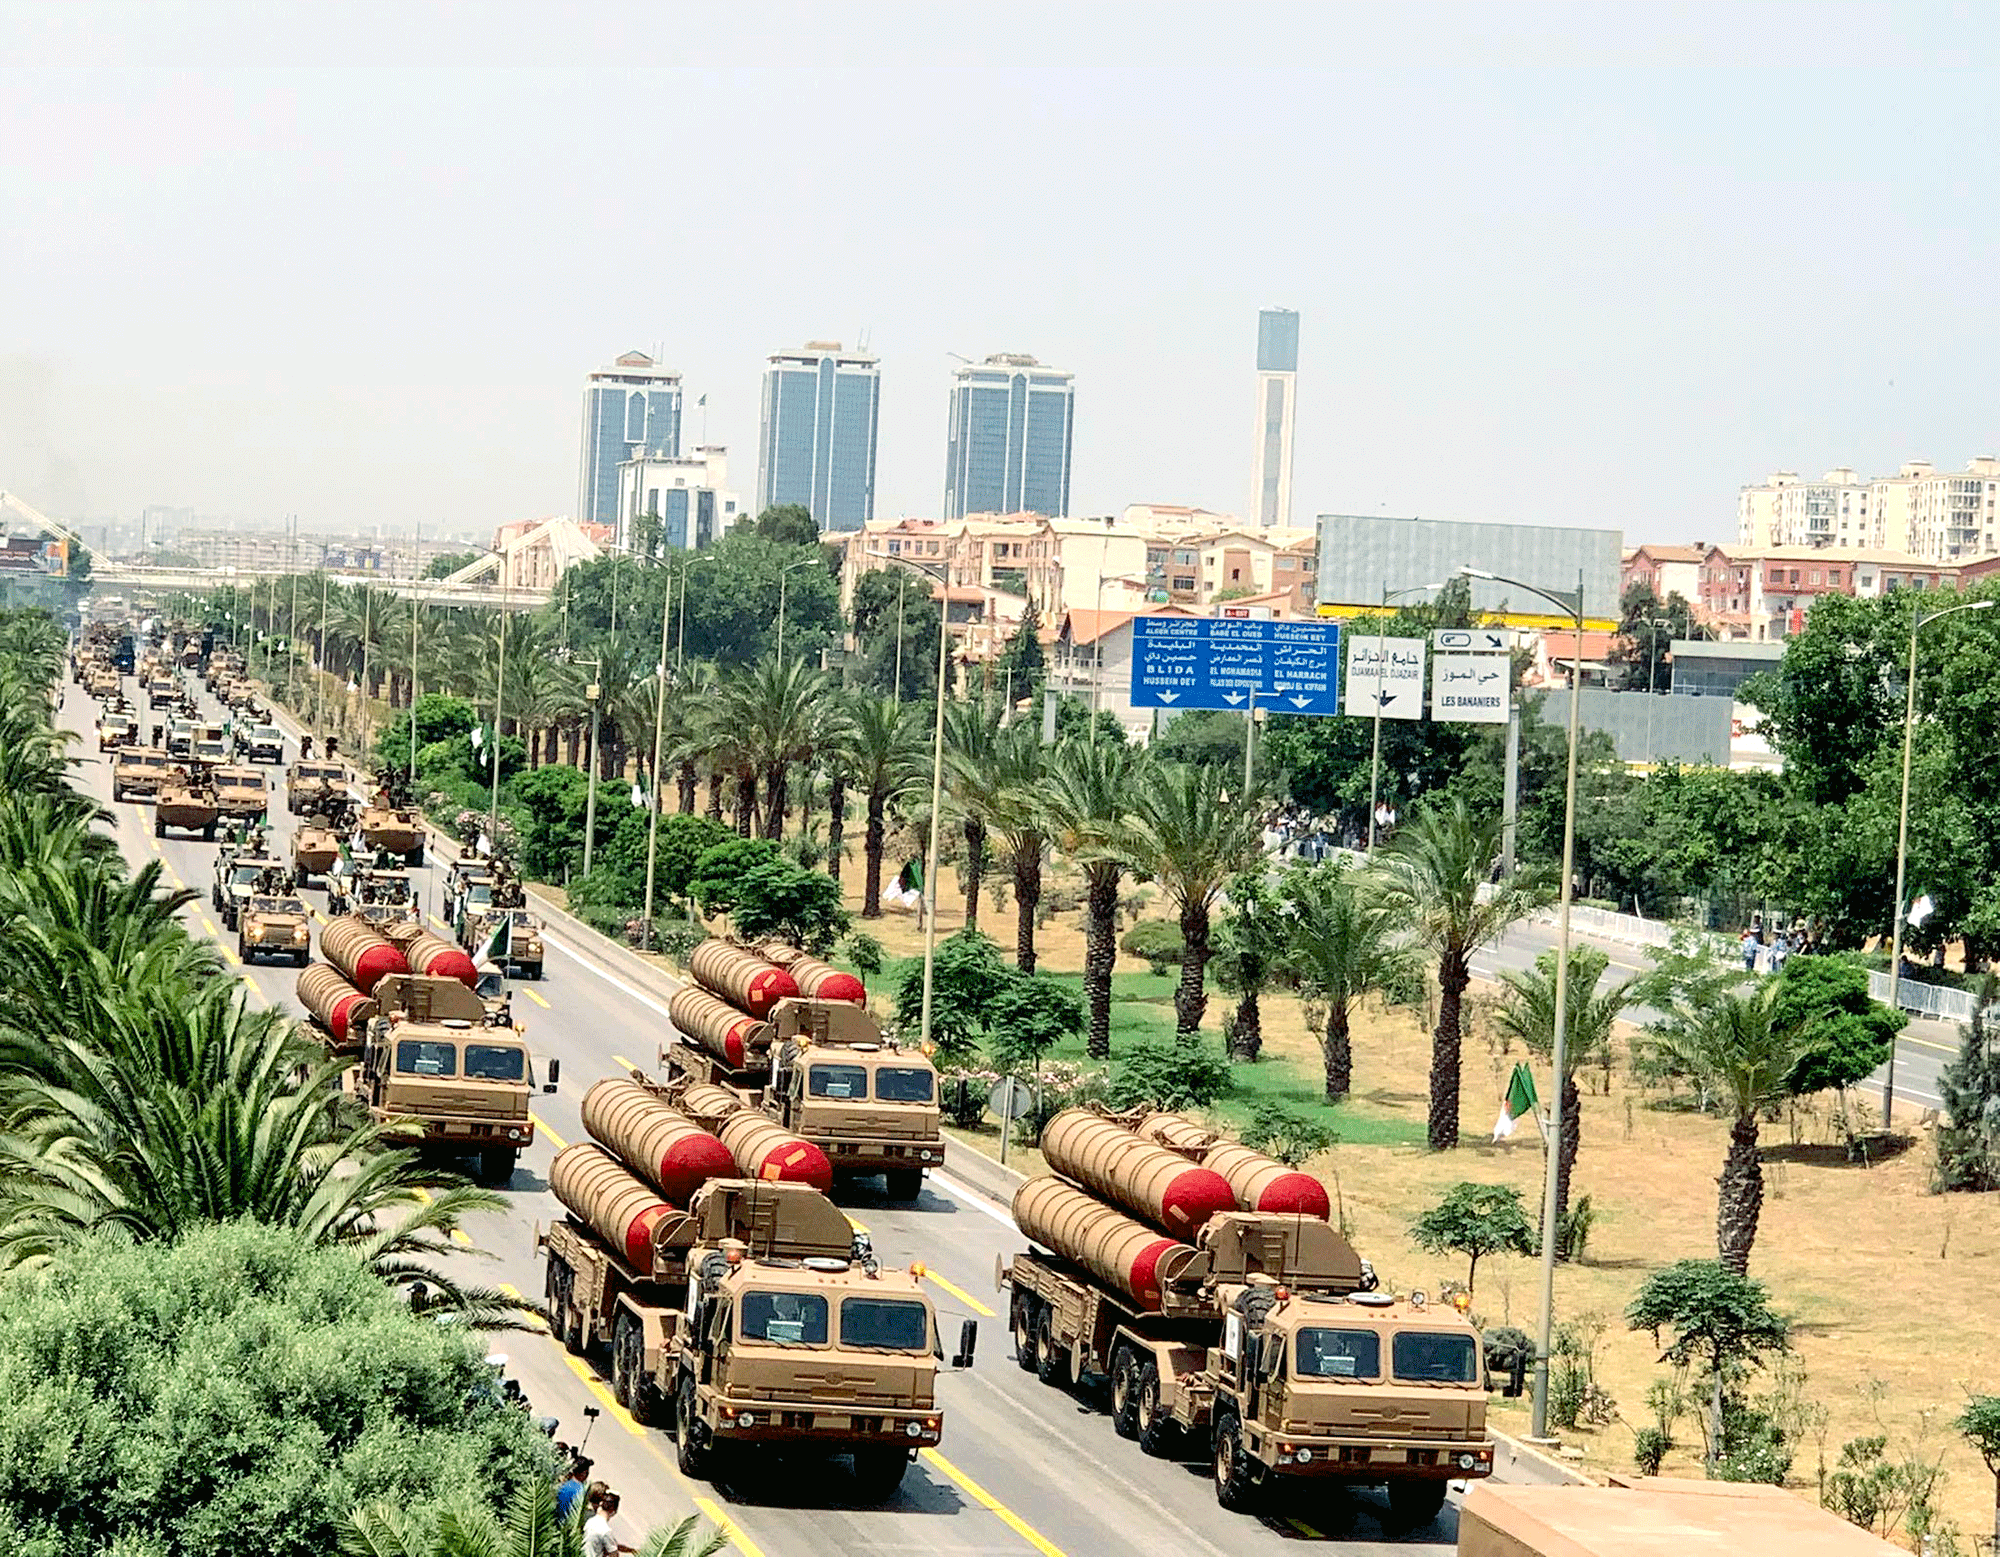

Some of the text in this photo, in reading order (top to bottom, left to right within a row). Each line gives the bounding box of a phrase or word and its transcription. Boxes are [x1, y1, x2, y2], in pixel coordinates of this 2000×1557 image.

[1146, 664, 1194, 675] BLIDA
[1274, 669, 1327, 680] EL HARRACH
[1143, 676, 1179, 686] HUSSEIN
[1441, 696, 1500, 708] LES BANANIERS
